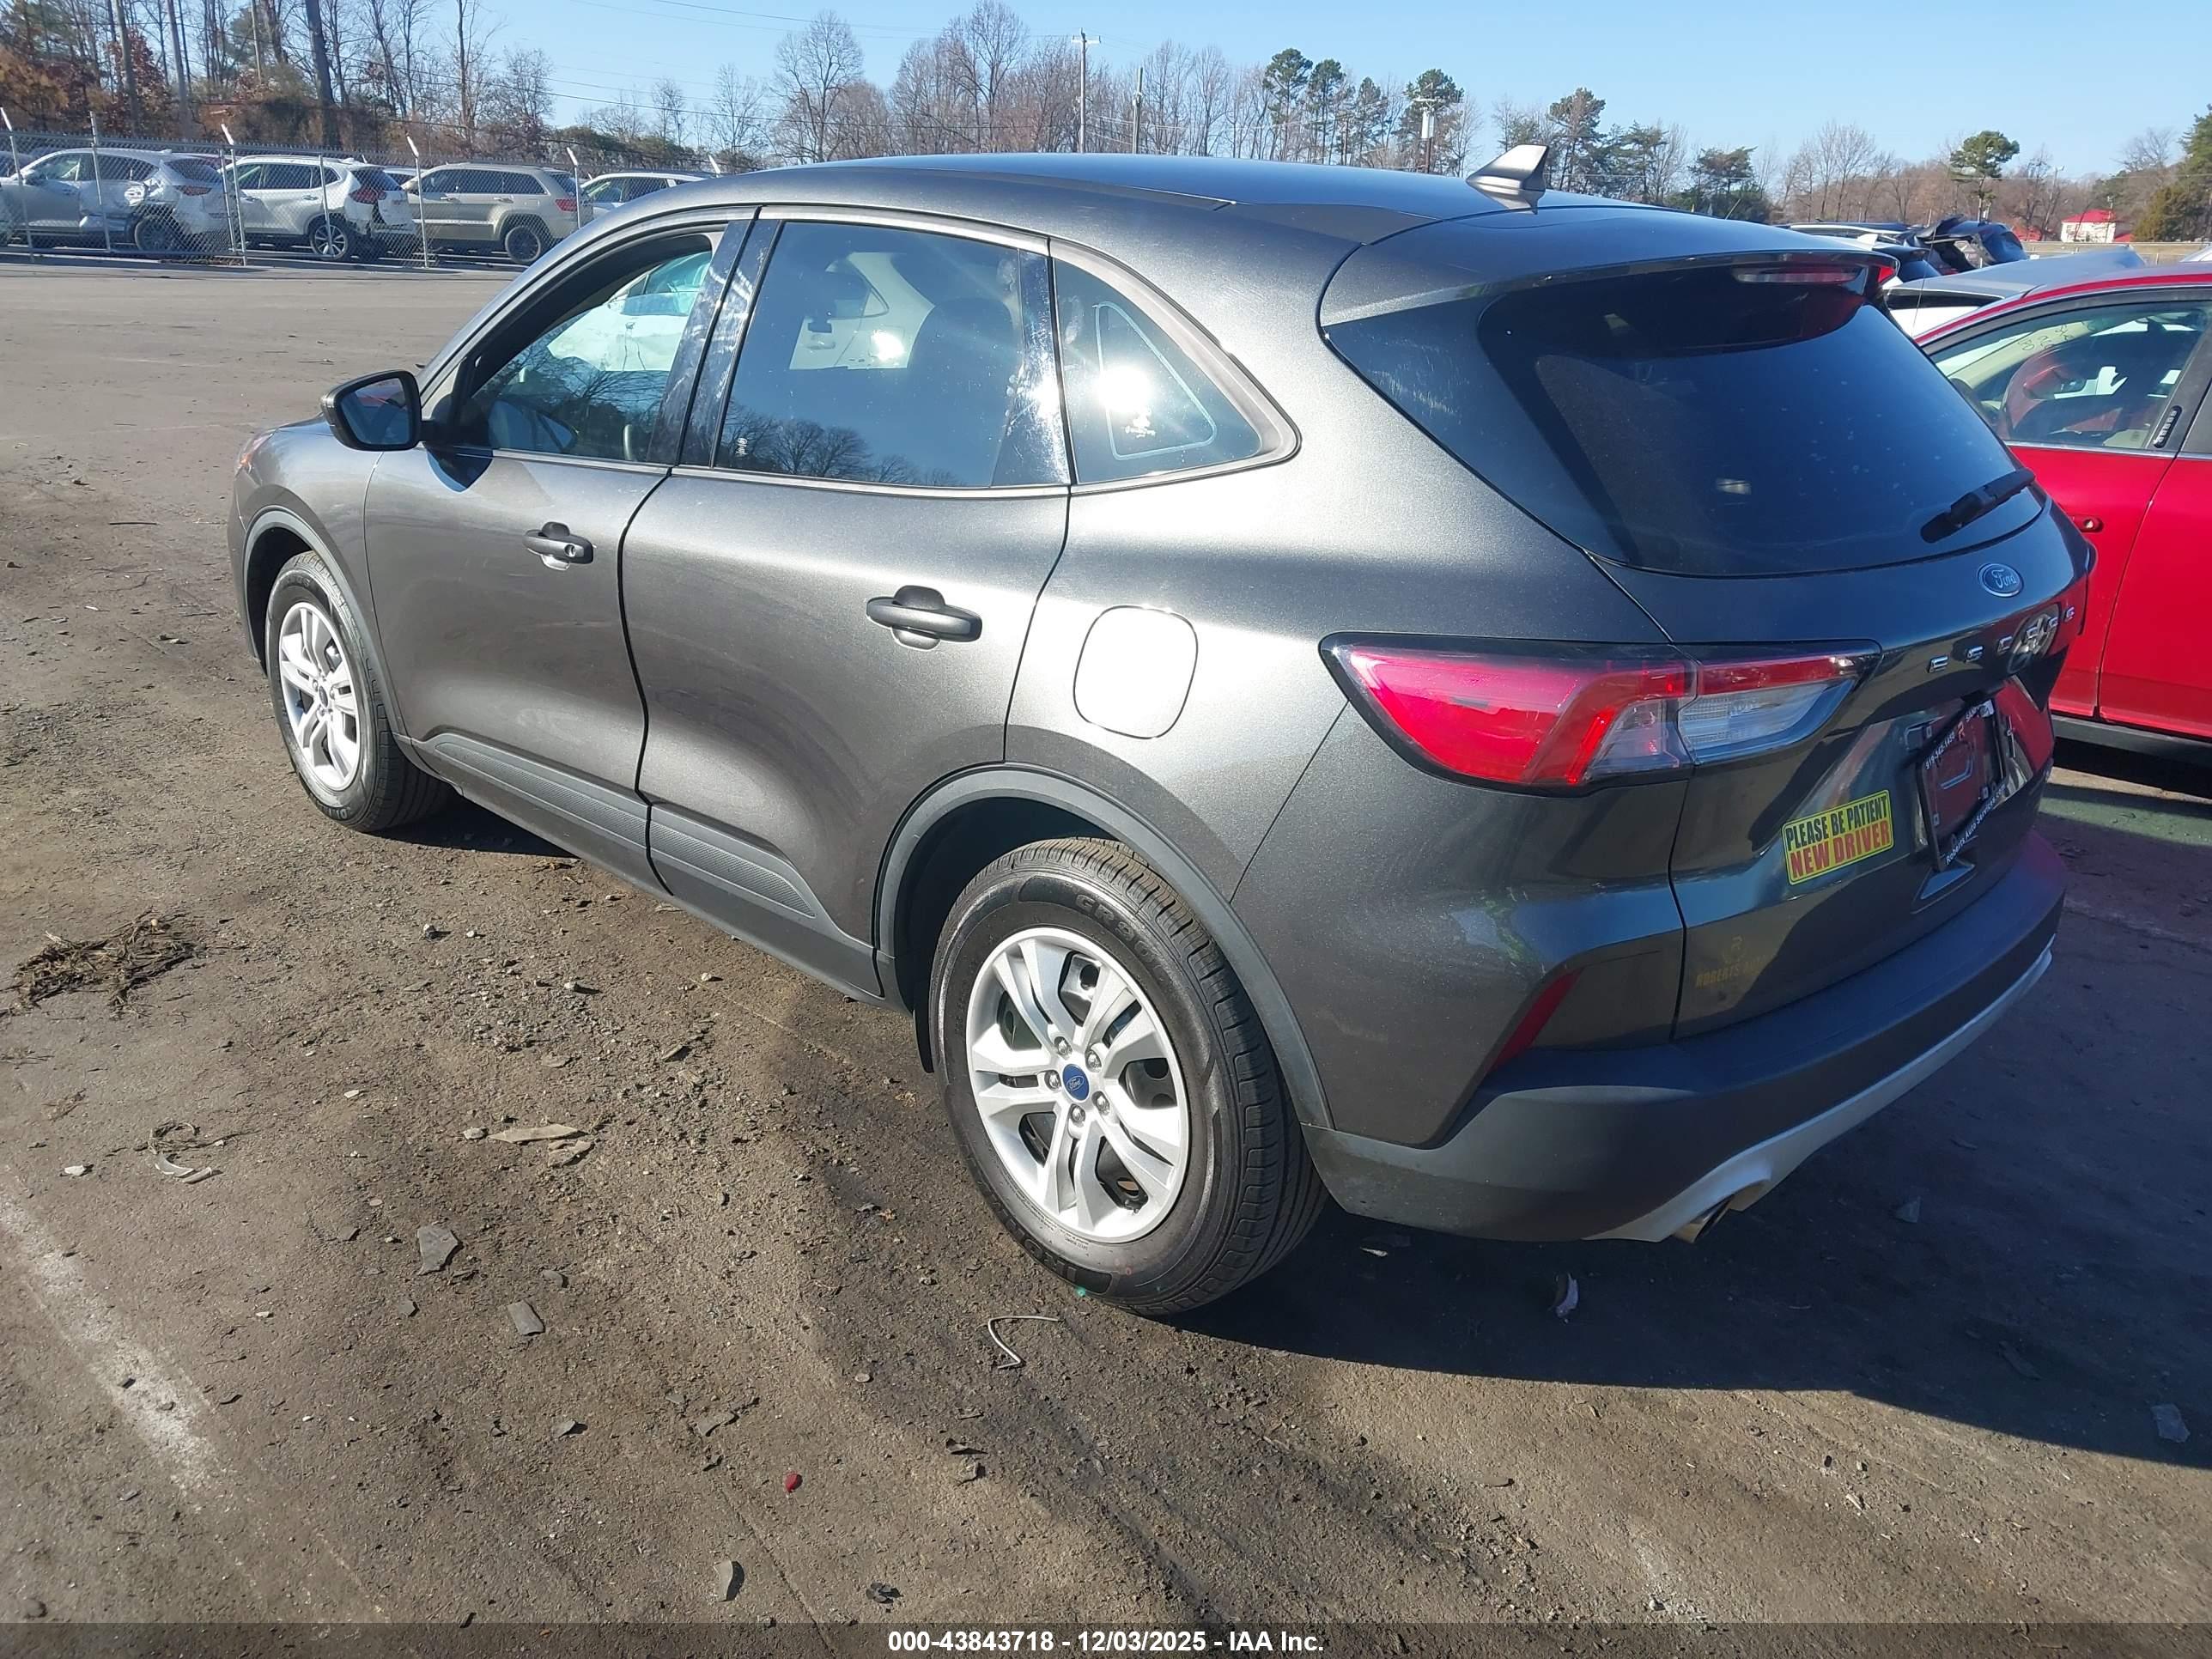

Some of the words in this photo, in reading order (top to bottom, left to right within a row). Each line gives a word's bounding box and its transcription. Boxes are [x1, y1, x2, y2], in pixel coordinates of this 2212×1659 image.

[1991, 568, 2017, 588] Ford
[1785, 816, 1829, 851] PLEASE
[1830, 810, 1845, 836] BE
[1846, 796, 1888, 830] PATIENT
[1965, 823, 1977, 841] Auto
[1790, 842, 1830, 878] NEW
[1833, 820, 1890, 864] DRIVER
